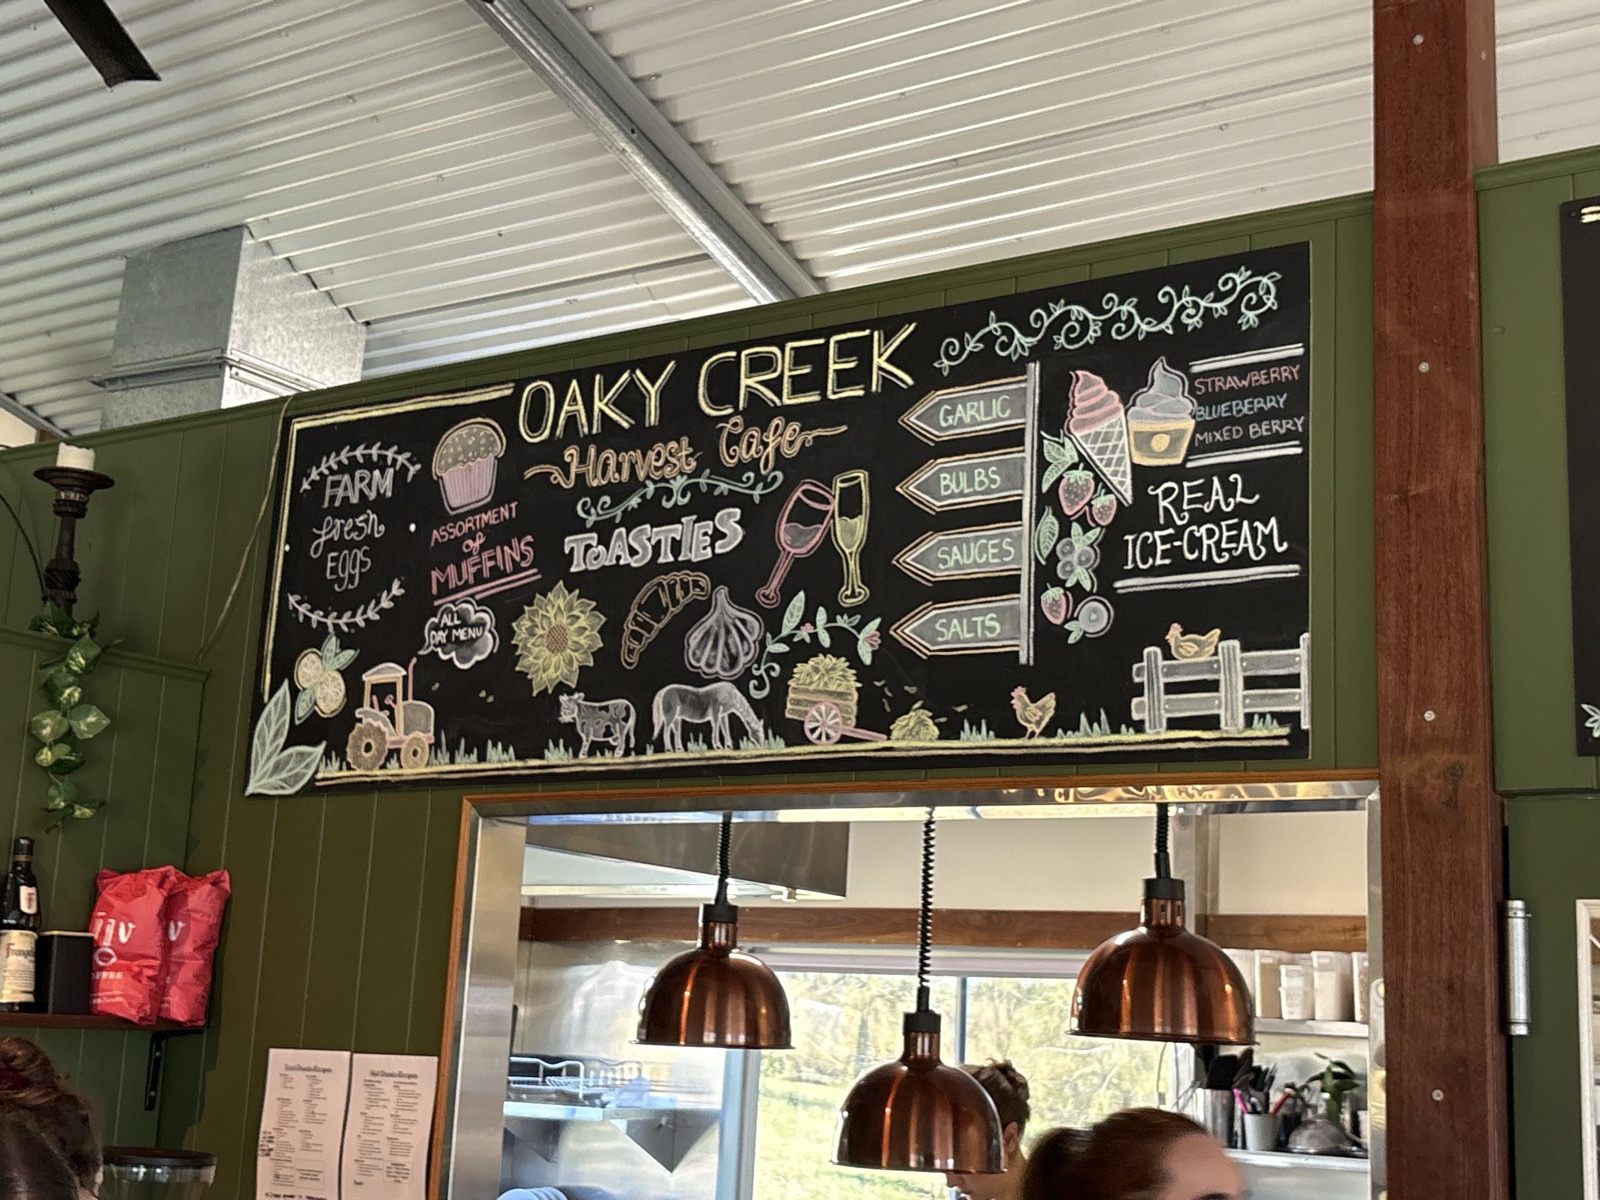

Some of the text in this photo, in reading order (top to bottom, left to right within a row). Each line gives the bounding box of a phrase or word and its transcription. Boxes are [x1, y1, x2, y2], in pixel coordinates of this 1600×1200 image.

[519, 322, 917, 443] OAKY CREEK
[1194, 365, 1300, 396] STRAWBERRY
[938, 395, 1011, 428] GARLIC
[1194, 393, 1288, 421] BLUEBERRY
[1194, 416, 1305, 447] MIXED BERRY
[524, 436, 703, 489] Harvest
[322, 468, 394, 508] FARM
[939, 466, 1001, 496] BULBS
[1148, 474, 1260, 525] REAL
[430, 501, 519, 547] ASSORTMENT
[462, 532, 487, 555] of
[936, 537, 1015, 570] SAUCES
[1123, 516, 1289, 570] ICE-CREAM
[430, 535, 535, 595] MUFFINS
[430, 626, 483, 645] DAY MENU
[440, 612, 462, 627] ALL
[934, 613, 1001, 642] SALTS
